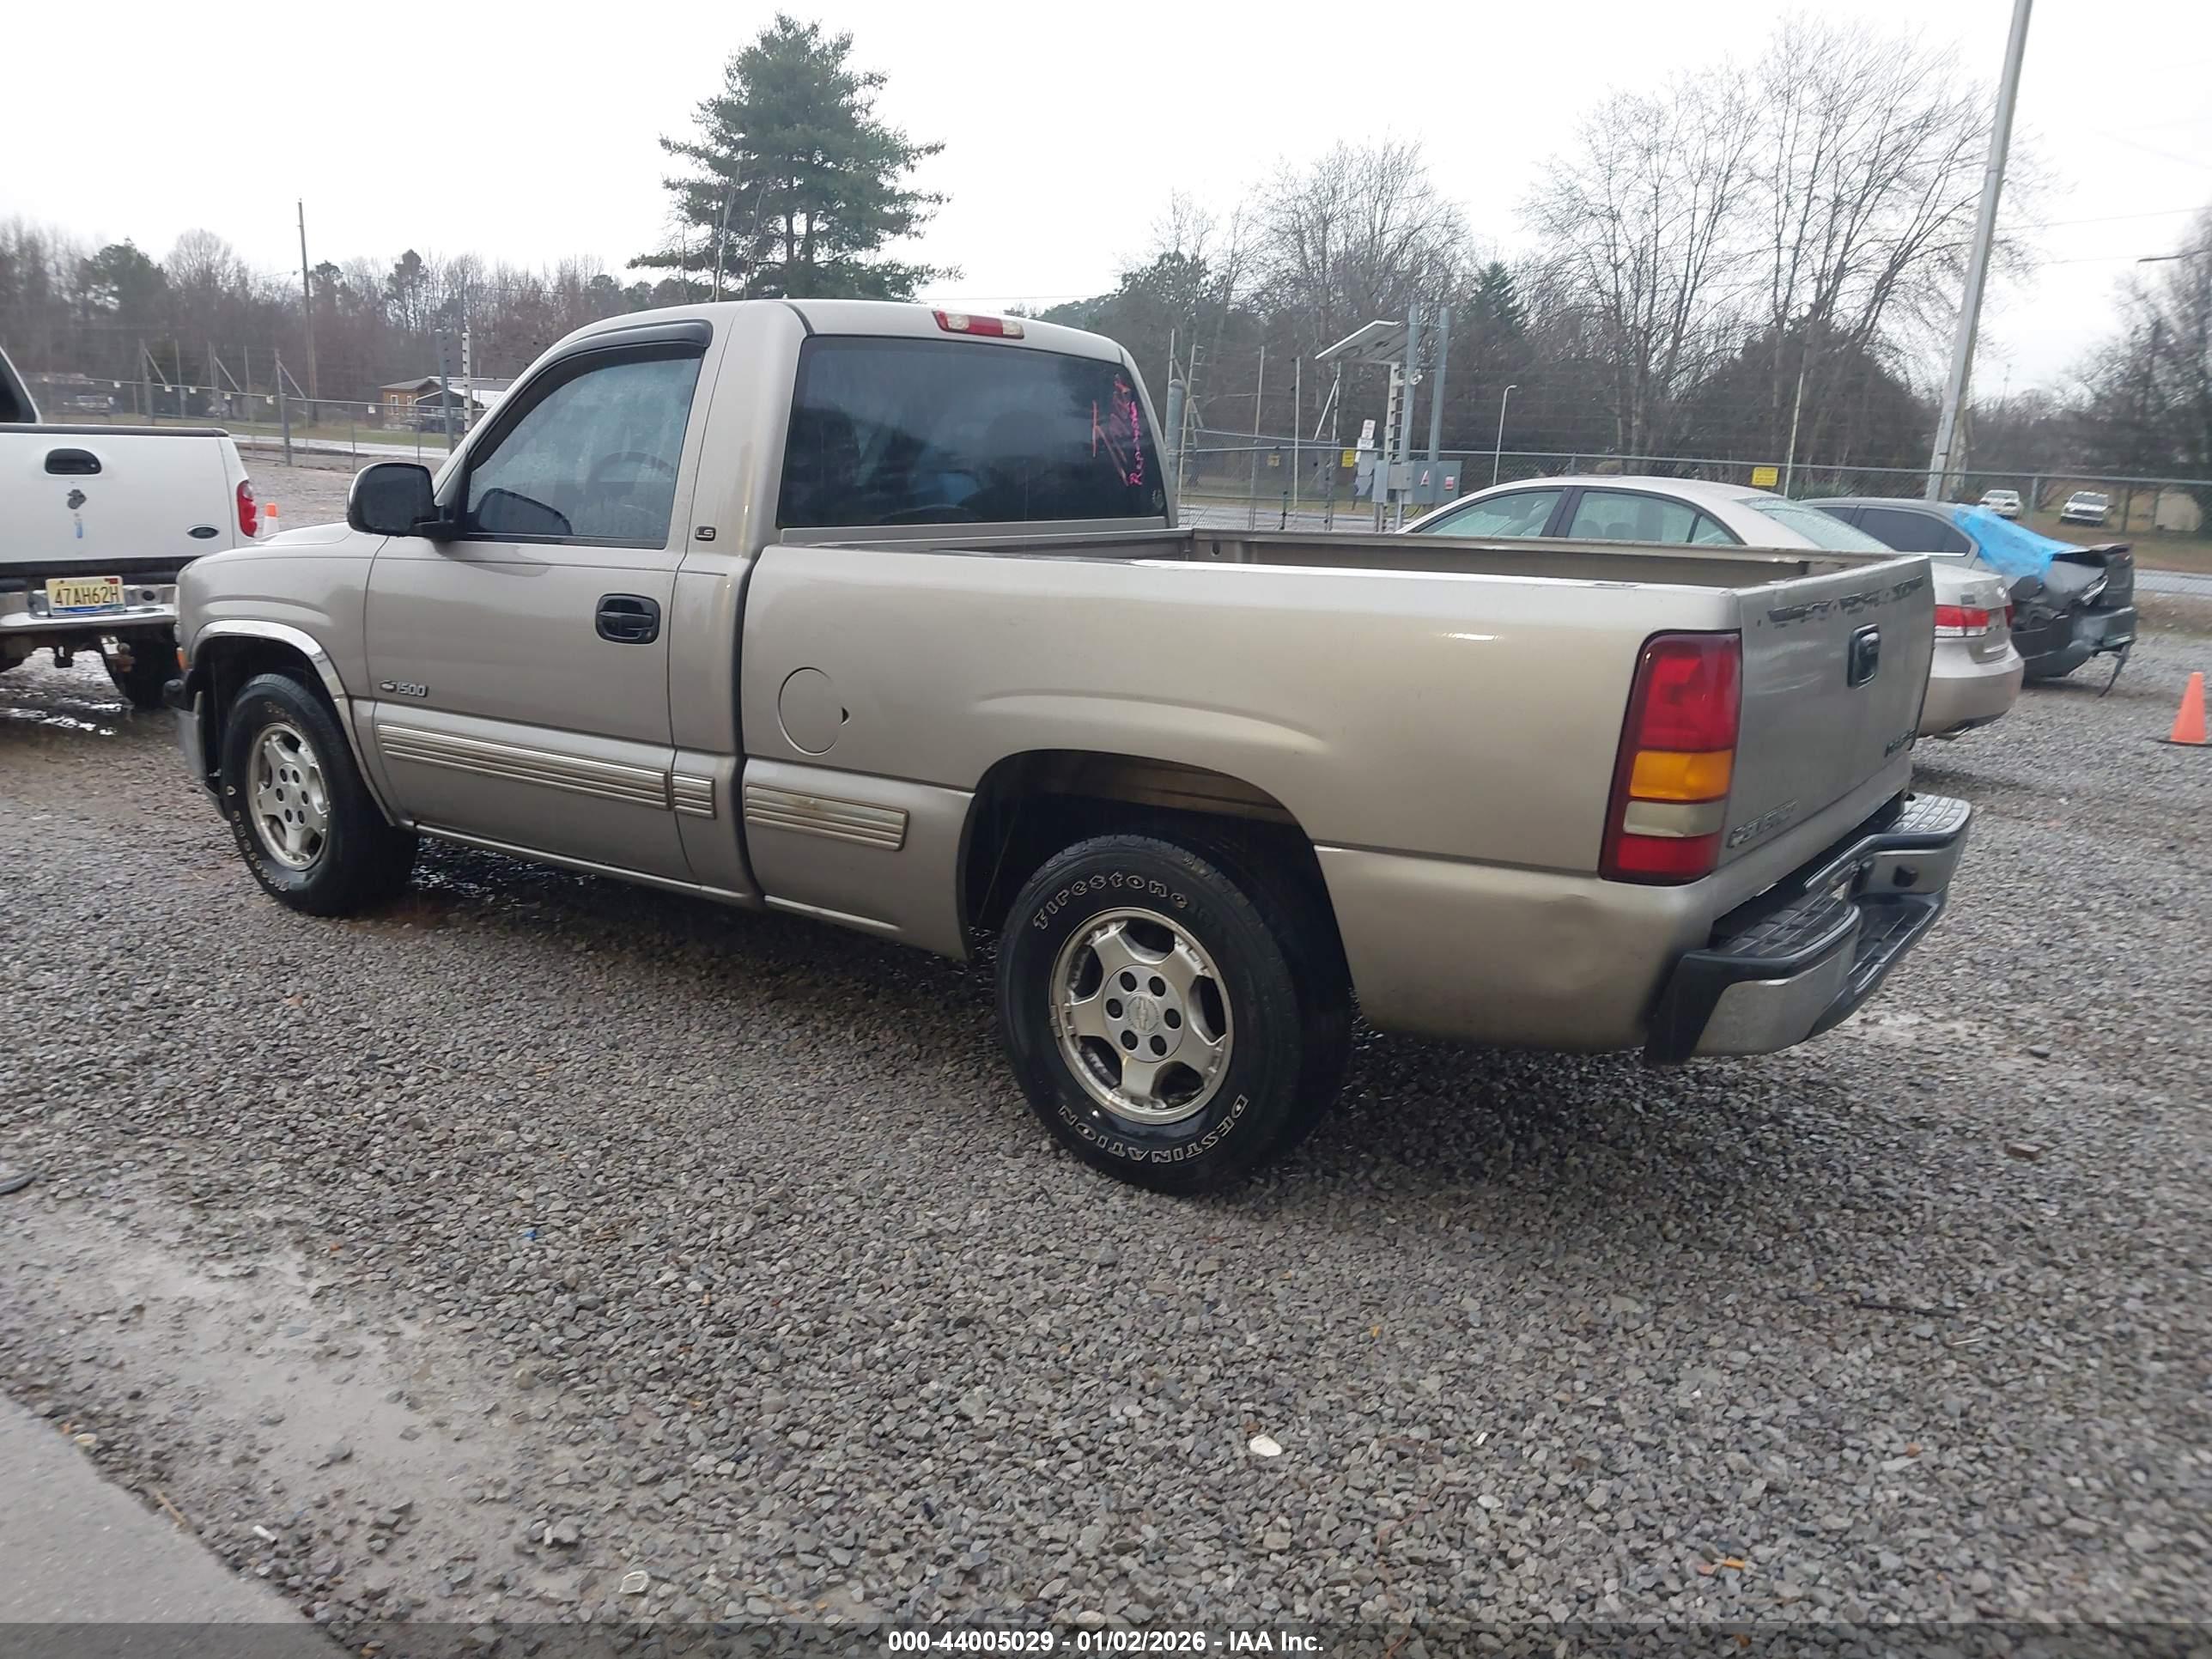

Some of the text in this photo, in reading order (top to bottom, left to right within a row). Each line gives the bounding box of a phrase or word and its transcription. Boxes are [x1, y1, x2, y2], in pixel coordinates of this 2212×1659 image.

[54, 586, 118, 605] 47AH62H
[1032, 871, 1188, 930] Firestone
[1058, 1094, 1249, 1163] DESTINATION
